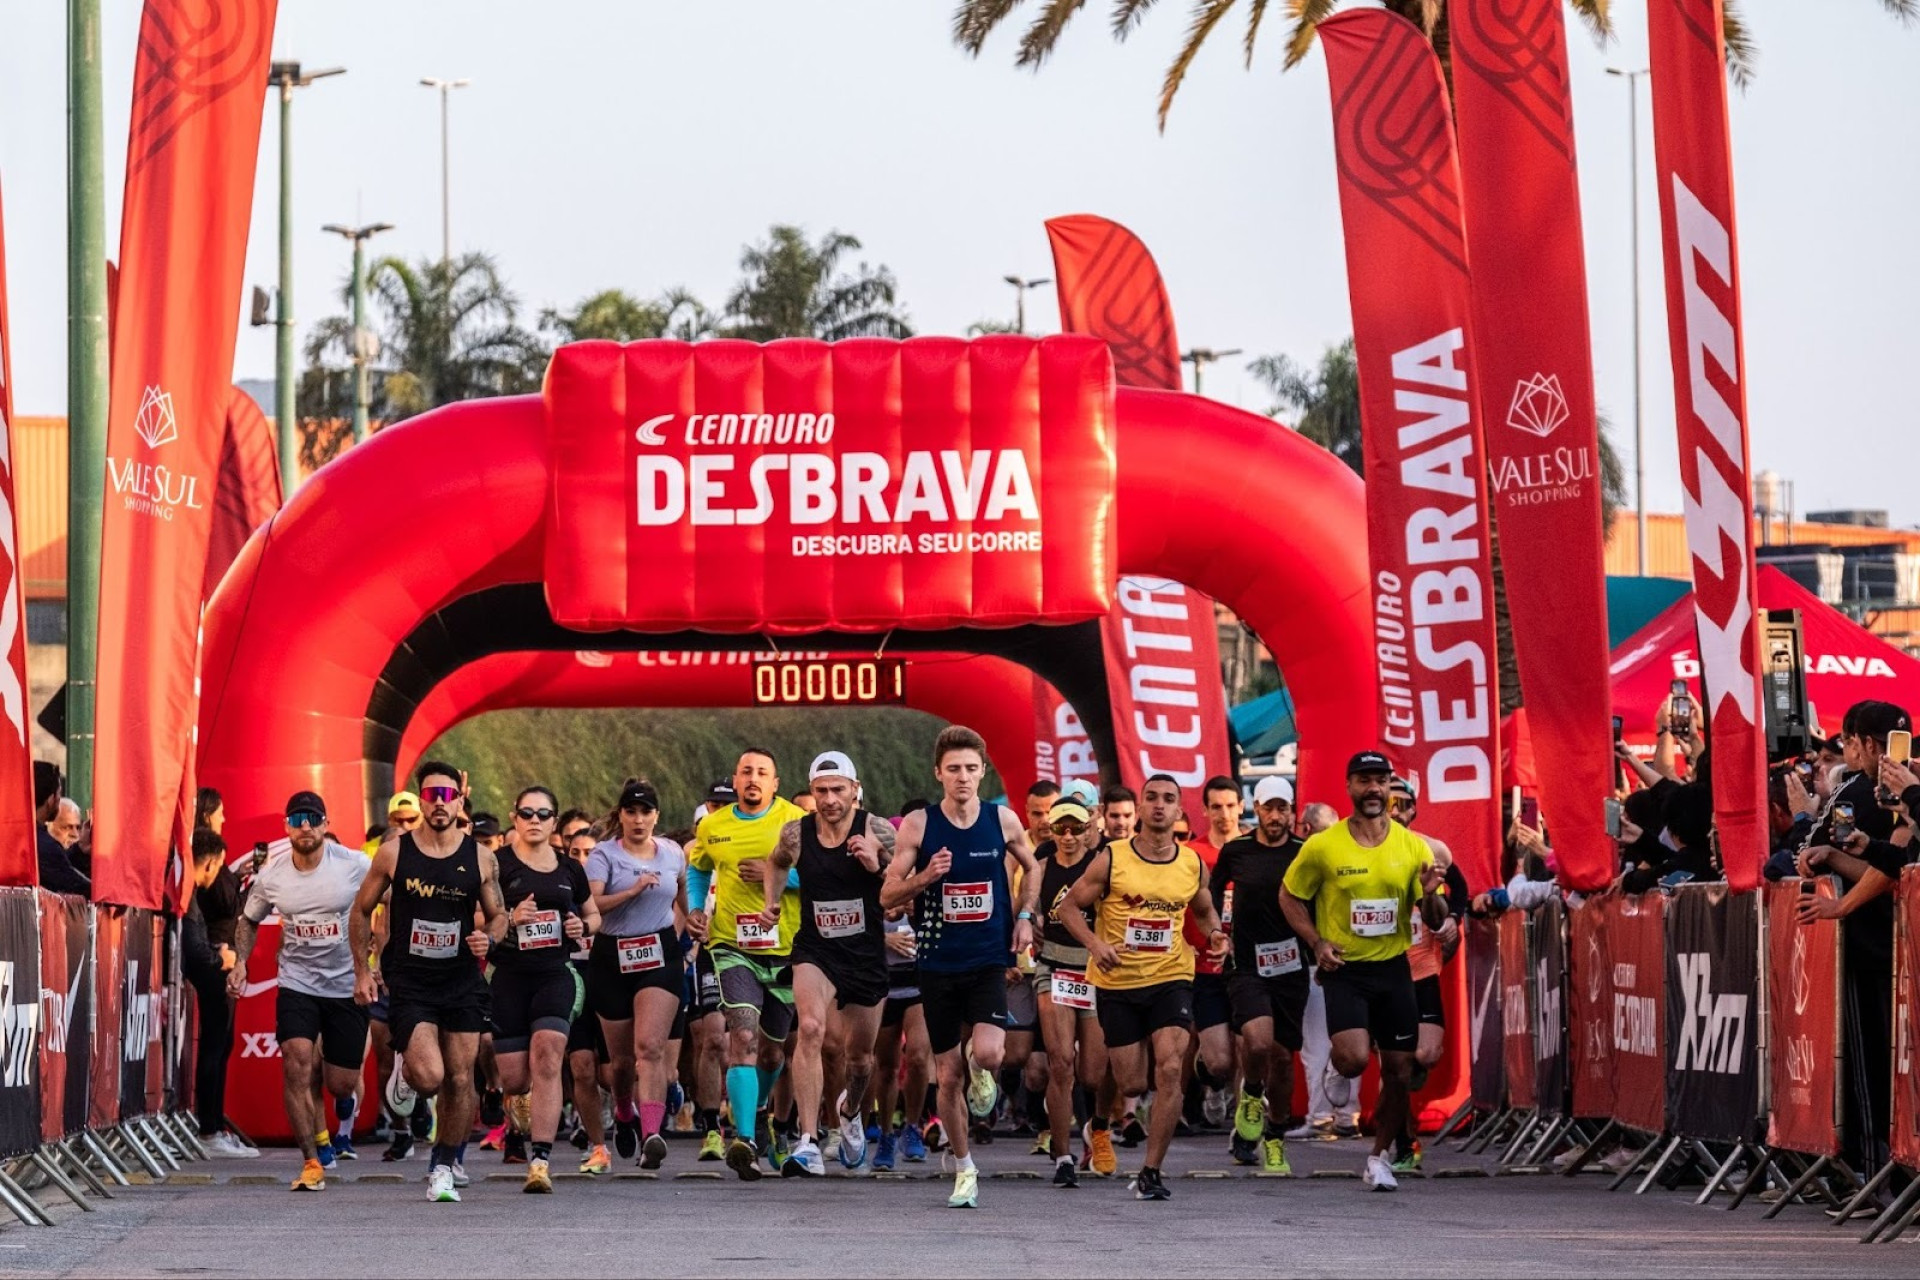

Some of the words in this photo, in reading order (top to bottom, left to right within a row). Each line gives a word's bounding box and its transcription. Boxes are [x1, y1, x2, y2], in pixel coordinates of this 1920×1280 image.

[684, 413, 835, 445] CENTAURO
[636, 449, 1040, 526] DESBRAVA
[1508, 484, 1580, 507] SHOPPING
[124, 496, 174, 521] SHOPPING
[792, 534, 913, 557] DESCUBRA
[917, 533, 964, 554] SEU
[966, 531, 1043, 554] CORRE
[1391, 327, 1492, 802] DESBRAVA
[1377, 570, 1416, 747] CENTAURO
[951, 896, 983, 909] 5.130
[819, 913, 857, 927] 10.097
[1355, 911, 1391, 925] 10.280
[299, 924, 335, 937] 10.067
[526, 923, 553, 937] 5.190
[1134, 930, 1164, 942] 5.381
[418, 933, 452, 947] 10.190
[626, 947, 653, 961] 5.081
[1058, 981, 1088, 996] 5.269
